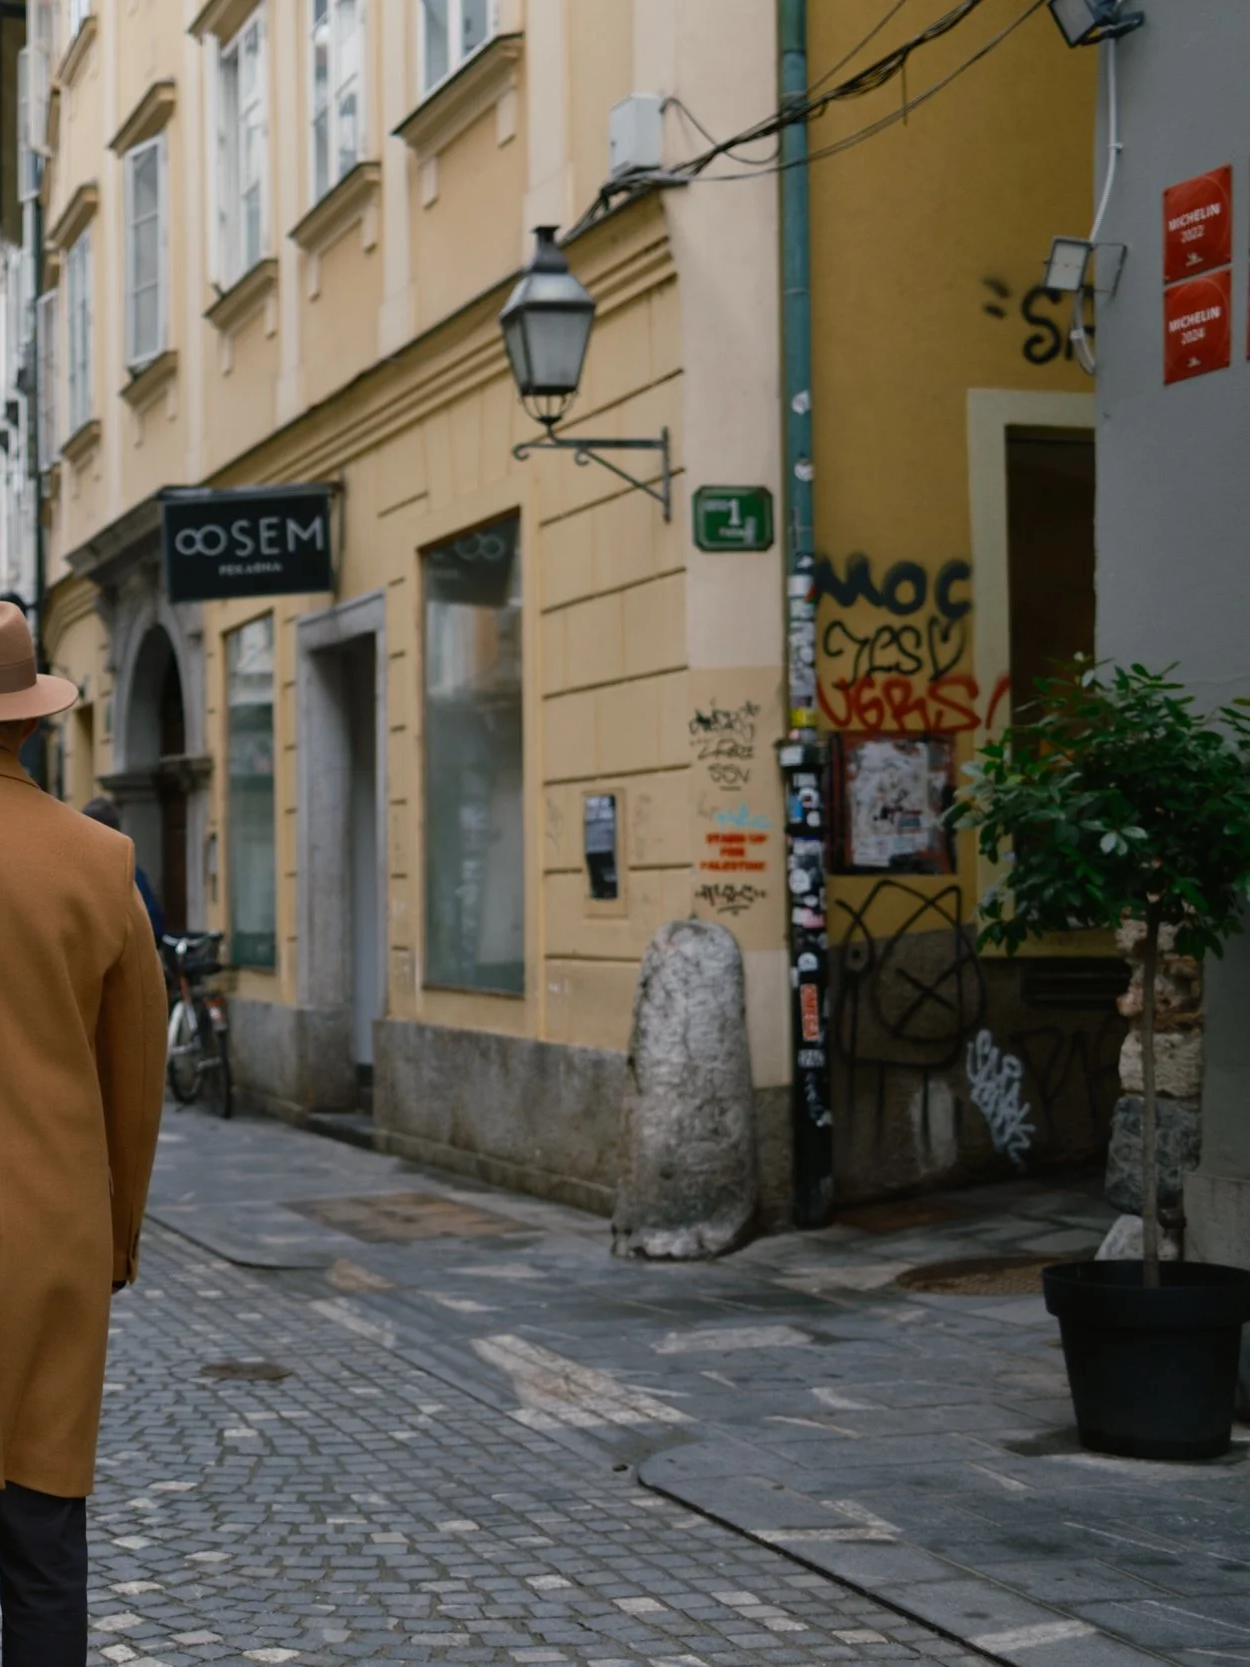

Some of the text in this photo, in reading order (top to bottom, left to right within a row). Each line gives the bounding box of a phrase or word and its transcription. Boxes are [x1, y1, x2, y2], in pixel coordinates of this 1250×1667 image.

[1168, 202, 1222, 232] MICHELIN
[1168, 305, 1222, 333] MICHELIN
[728, 498, 743, 526] 1
